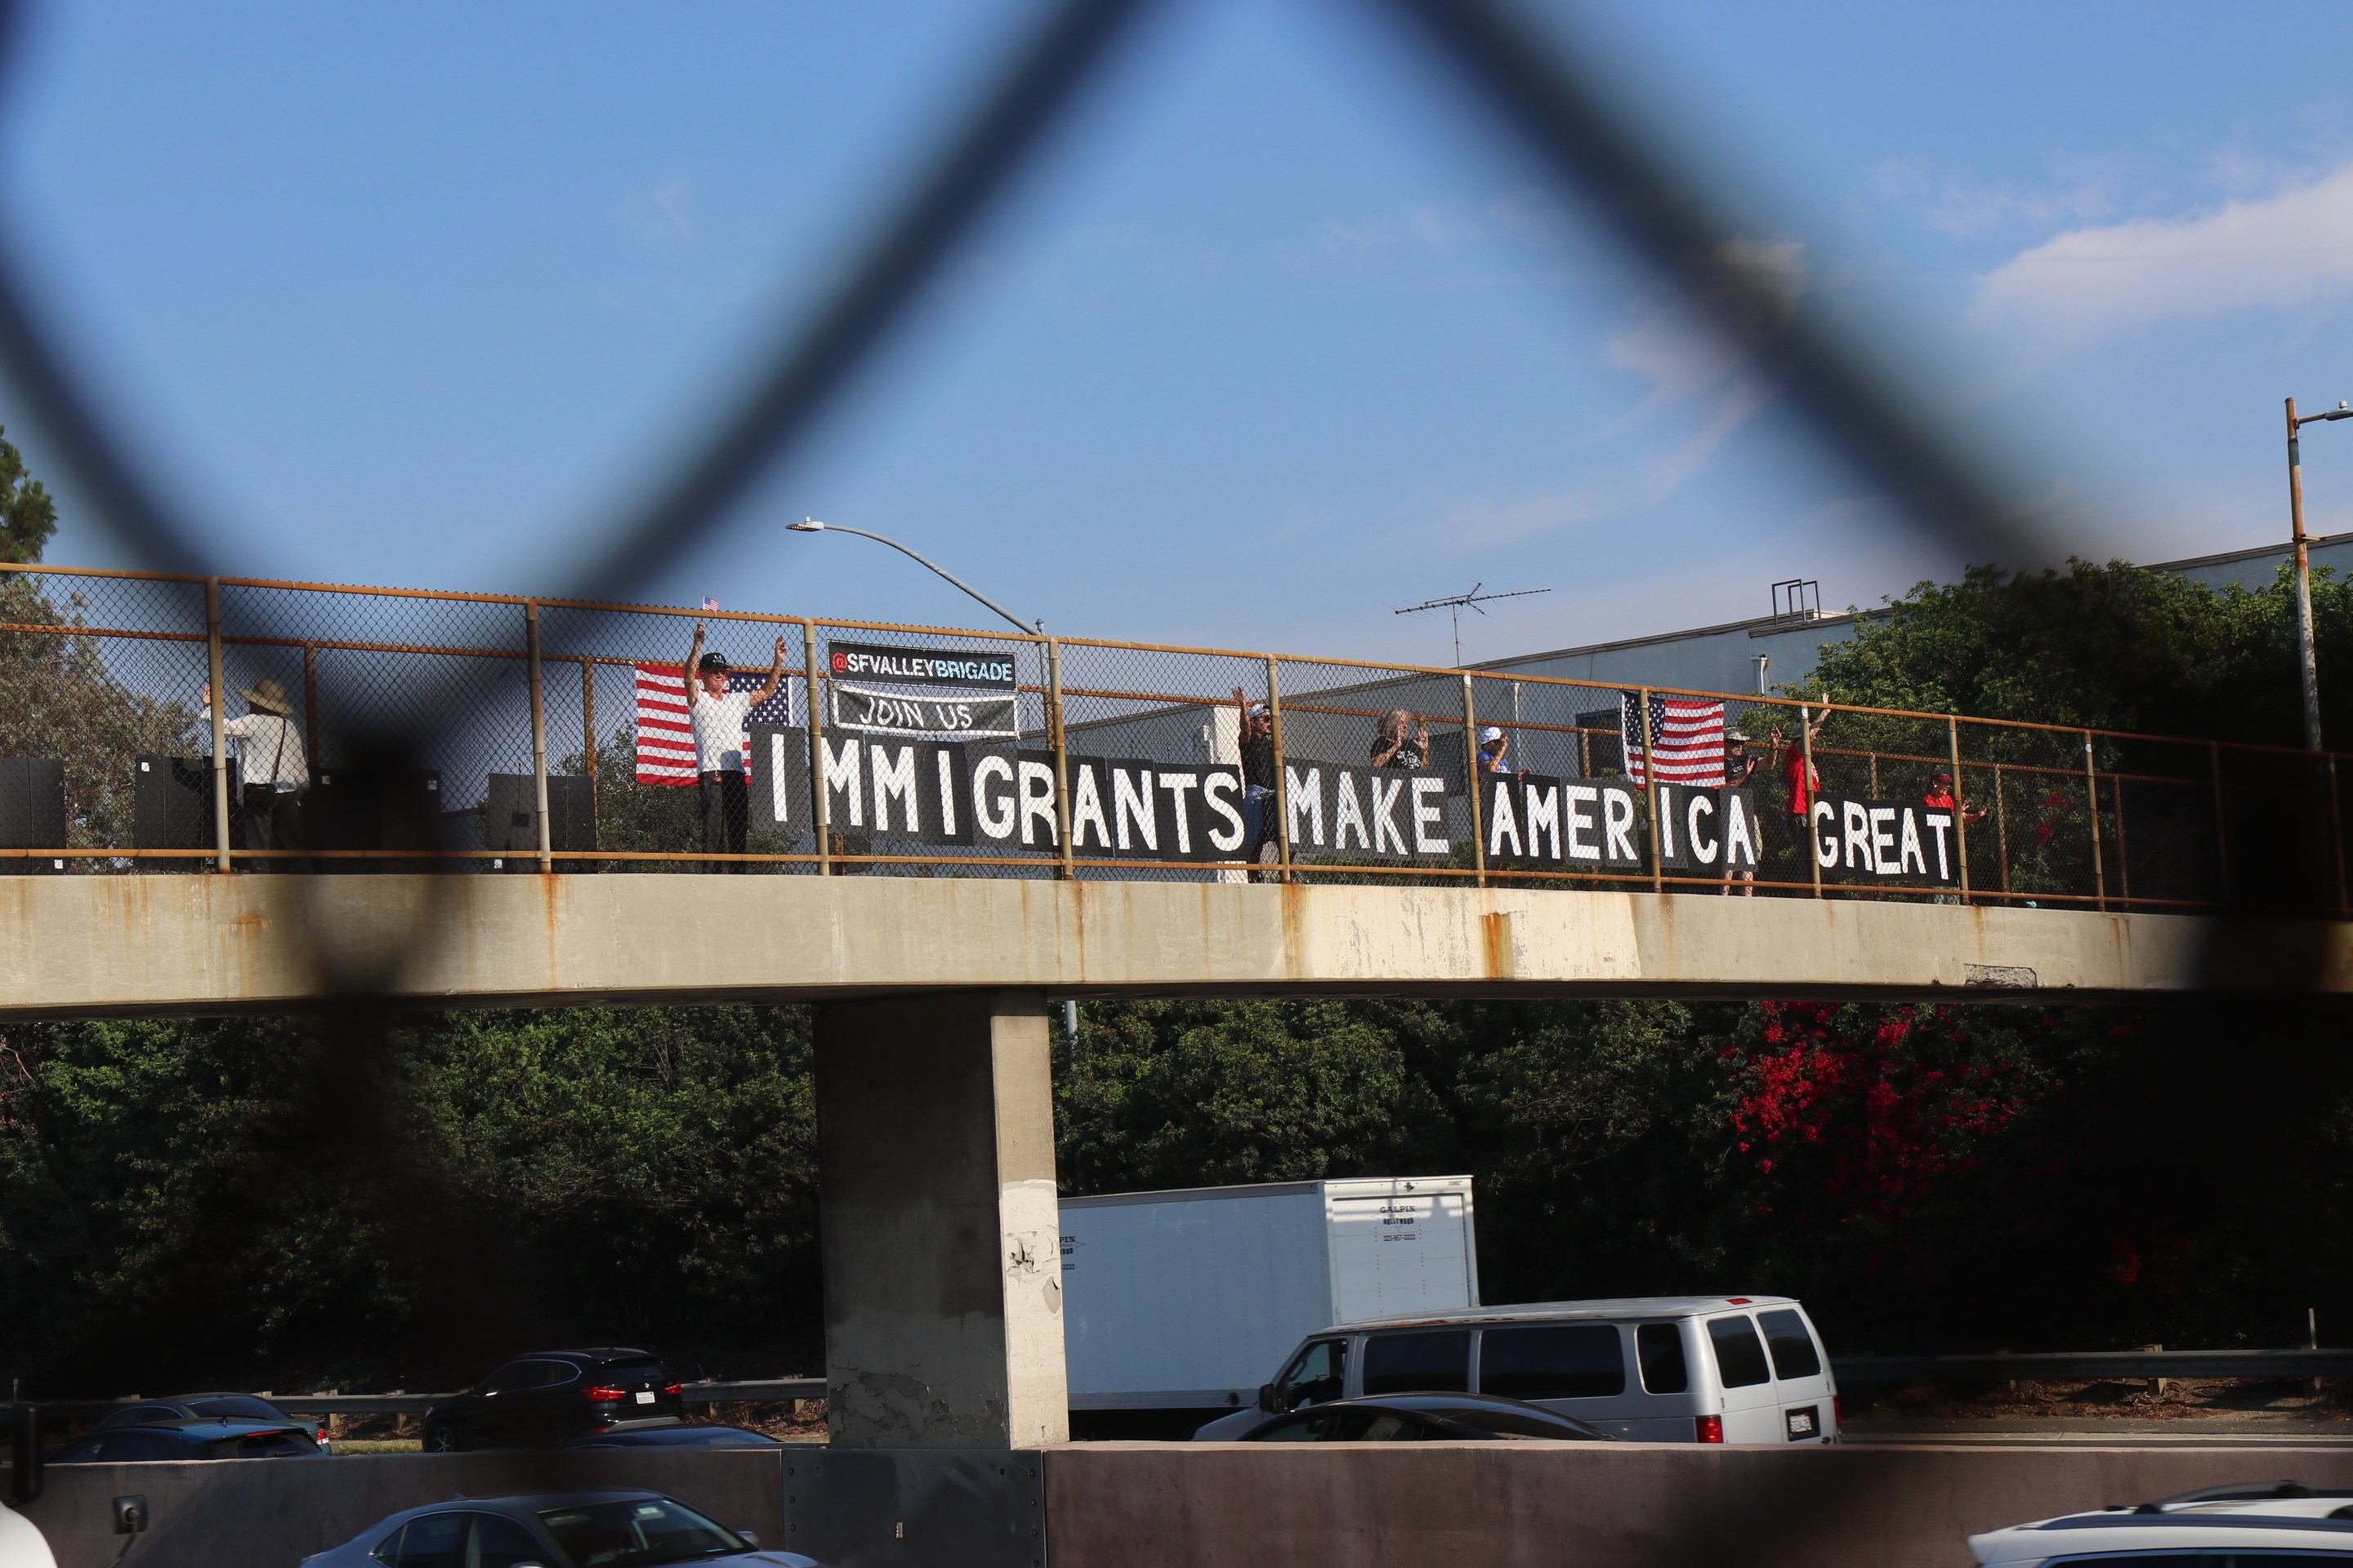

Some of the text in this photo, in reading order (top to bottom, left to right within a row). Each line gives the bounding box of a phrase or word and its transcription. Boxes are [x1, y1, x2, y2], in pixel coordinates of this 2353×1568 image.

[832, 651, 1013, 682] @SFVALLEYBRIGADE
[859, 697, 973, 730] JOIN US
[771, 733, 1952, 880] IMMIGRANTS MAKE AMERICA GREAT
